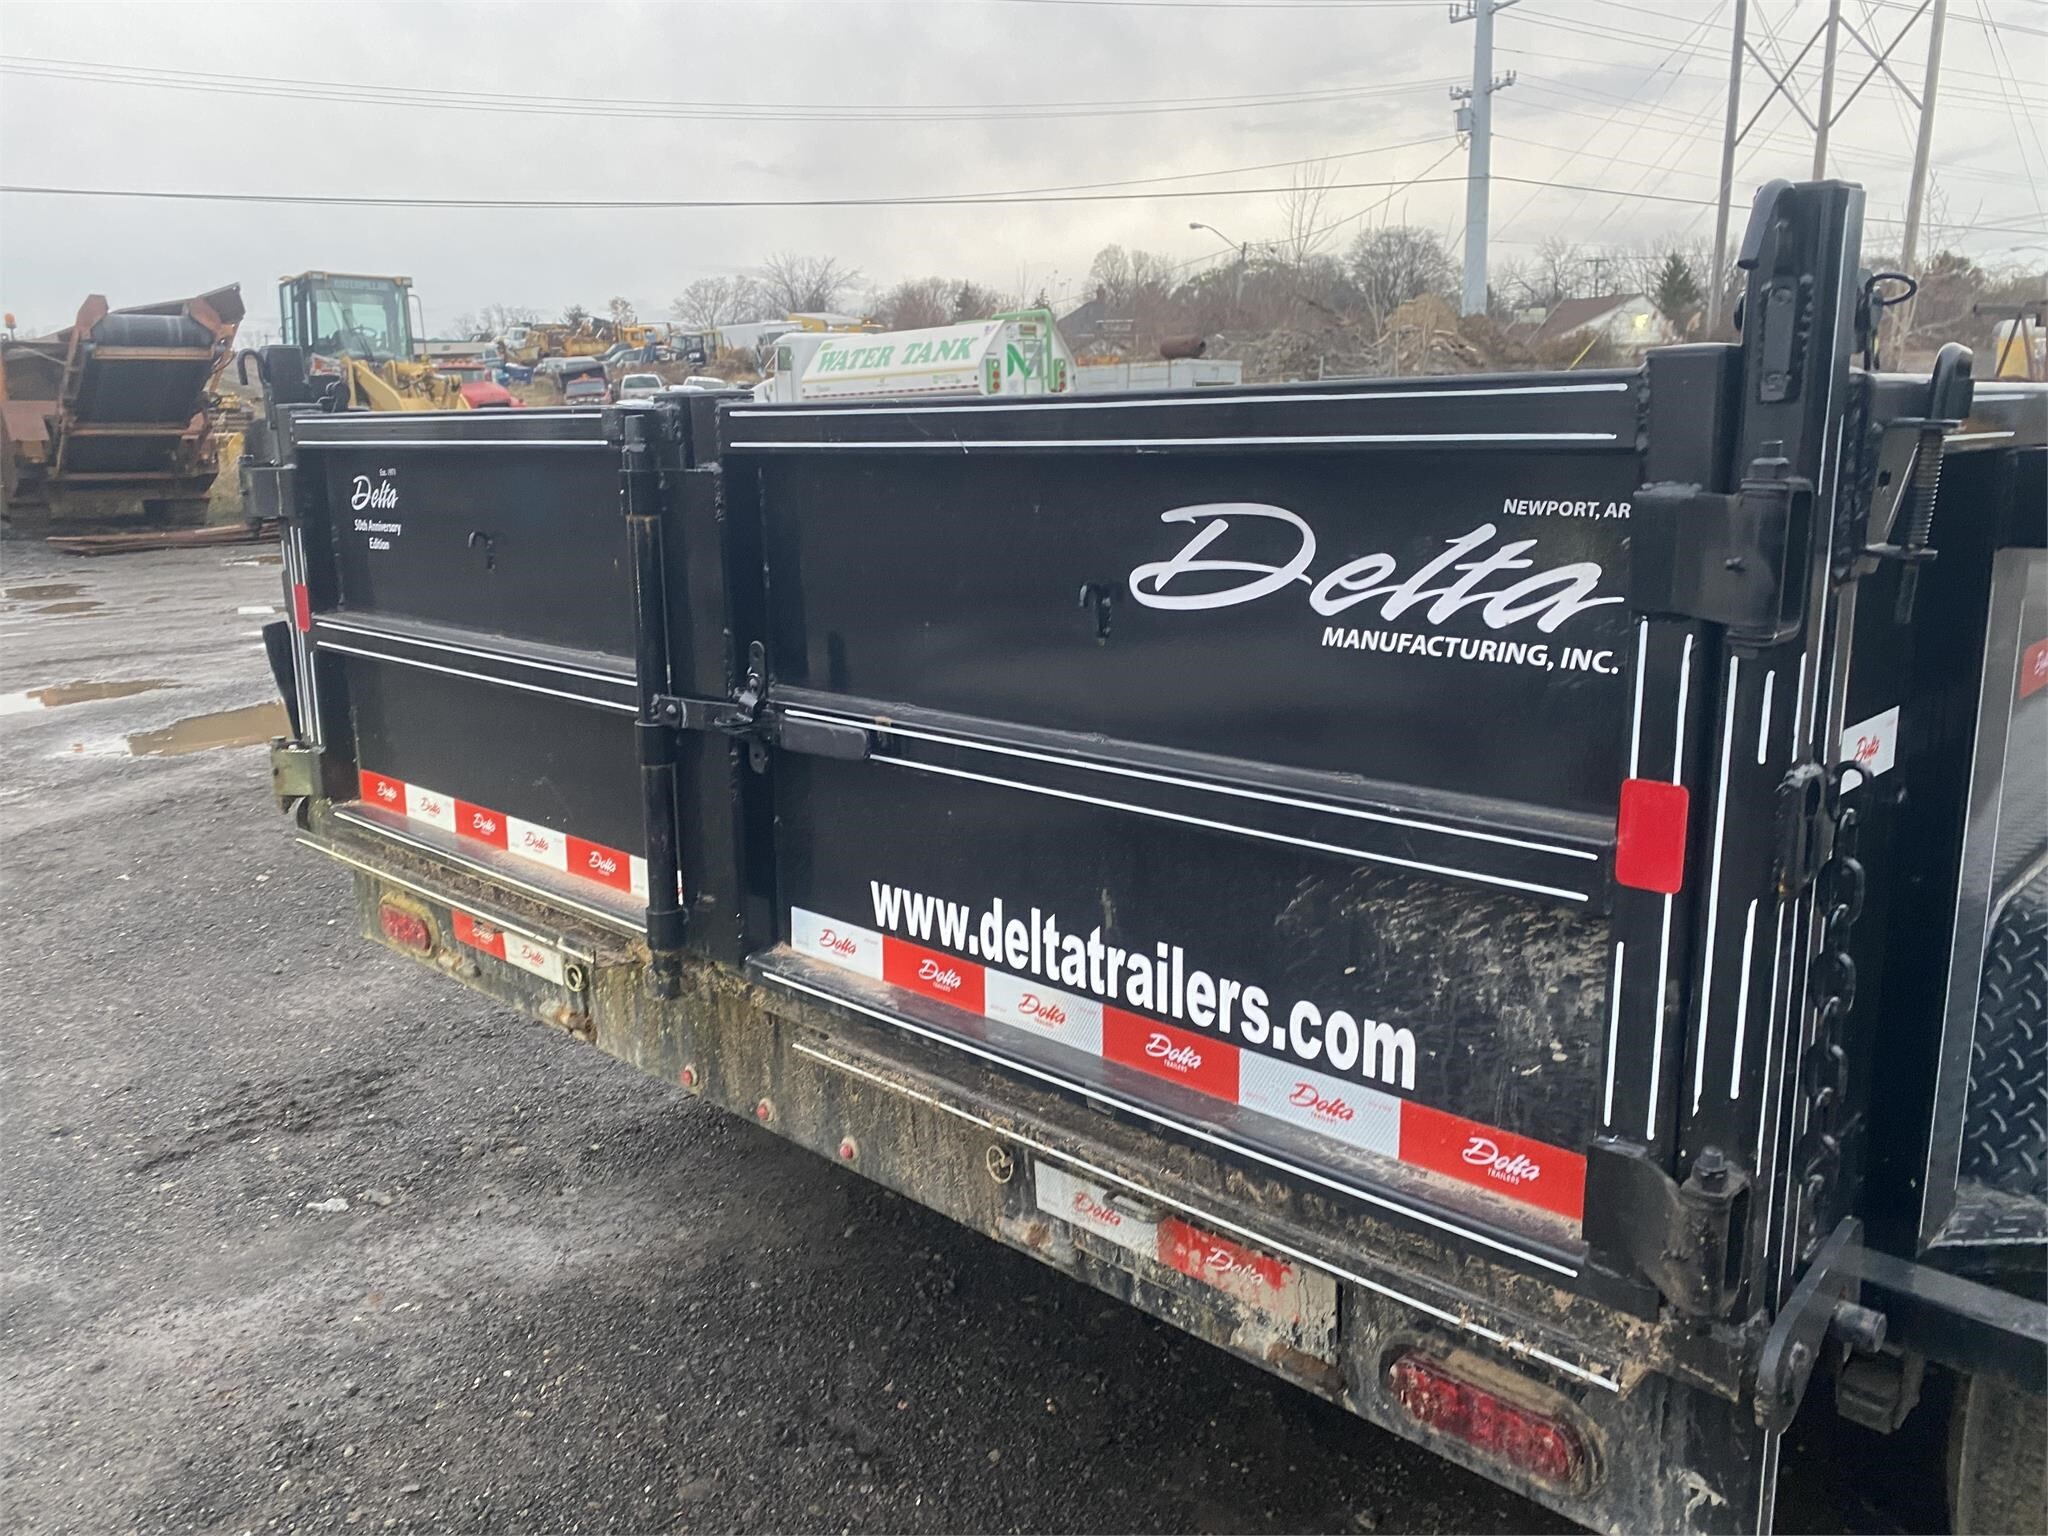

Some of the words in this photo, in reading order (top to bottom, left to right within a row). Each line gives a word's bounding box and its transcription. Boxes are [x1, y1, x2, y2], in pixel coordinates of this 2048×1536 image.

[817, 345, 895, 372] WATER
[901, 336, 979, 365] TANK
[351, 474, 399, 511] Delta
[1503, 499, 1600, 521] NEWPORT,
[1603, 502, 1632, 519] AR
[354, 519, 368, 532] 50th
[369, 519, 402, 537] Anniversary
[368, 537, 390, 550] Edition
[1129, 502, 1625, 633] Delta
[1321, 626, 1555, 672] MANUFACTURING,
[1560, 647, 1620, 675] INC.
[818, 928, 857, 956] Delta
[870, 880, 1417, 1092] www.deltatrailers.com
[917, 958, 962, 989] Delta
[1017, 992, 1067, 1025] Delta
[1144, 1032, 1203, 1070] Delta
[1163, 1058, 1188, 1074] TRAILERS
[1288, 1081, 1355, 1121] Delta
[1461, 1136, 1540, 1182] Delta
[1486, 1165, 1520, 1186] TRAILERS
